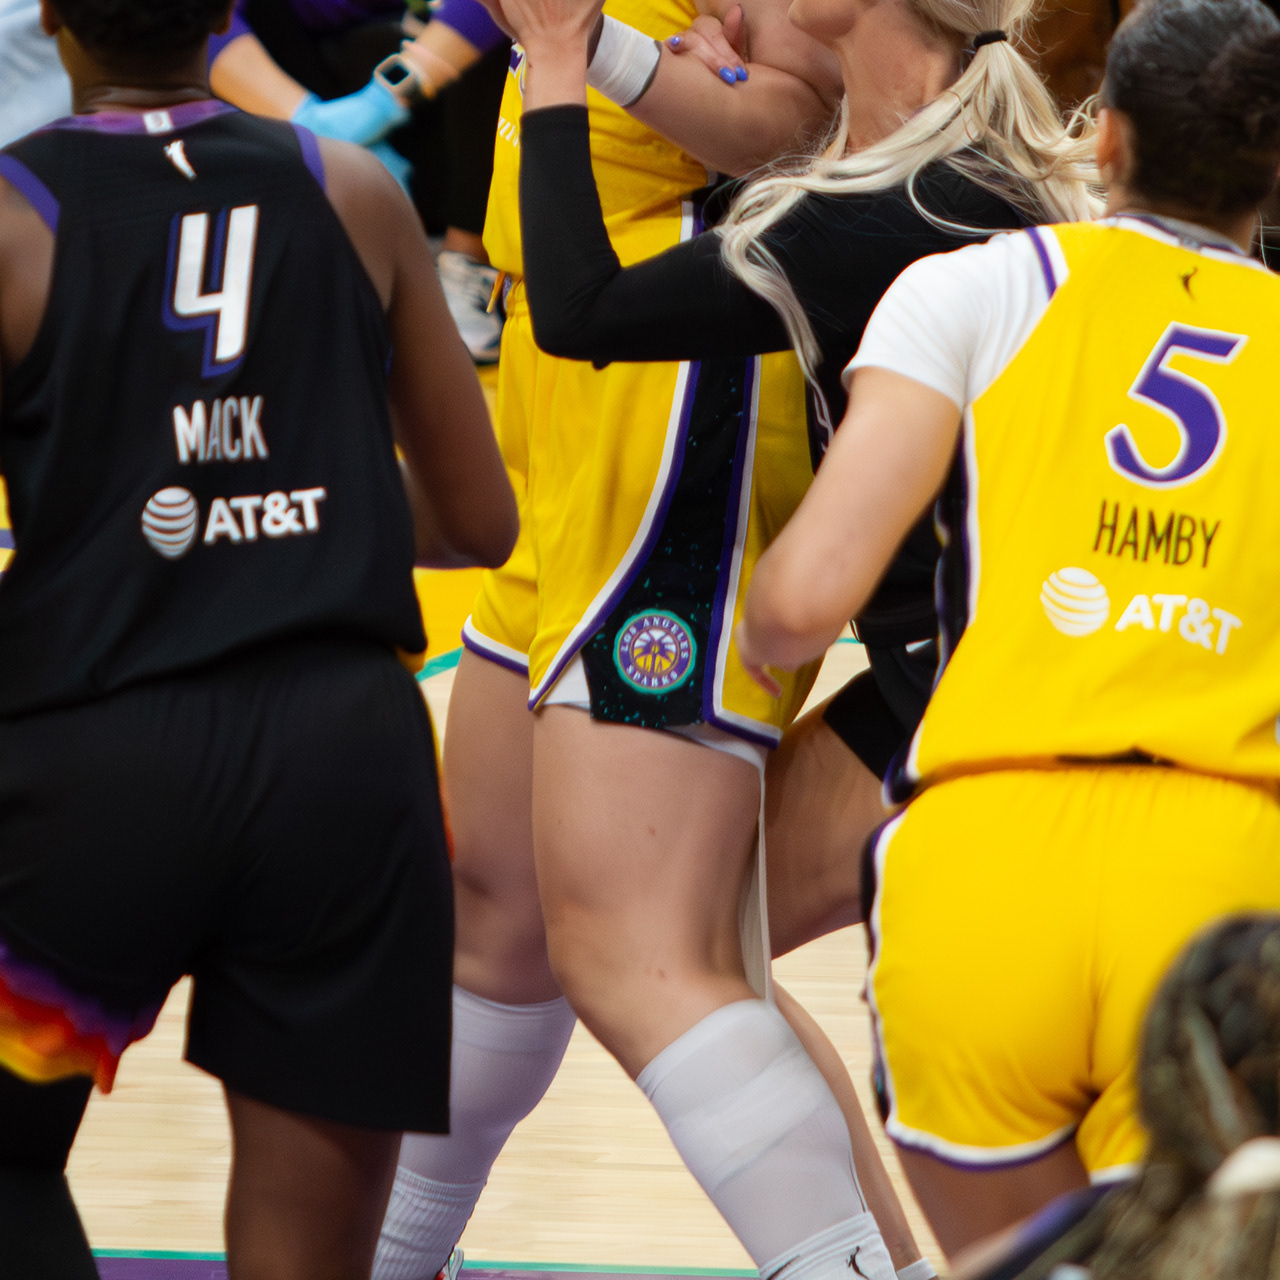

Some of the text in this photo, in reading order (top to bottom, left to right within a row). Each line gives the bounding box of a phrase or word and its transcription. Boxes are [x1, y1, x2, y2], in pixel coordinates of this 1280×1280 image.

[163, 204, 259, 377] 4
[172, 395, 269, 464] MACK
[1104, 321, 1249, 490] 5
[204, 486, 326, 546] AT&T
[1092, 499, 1221, 568] HAMBY
[1114, 592, 1243, 656] AT&T
